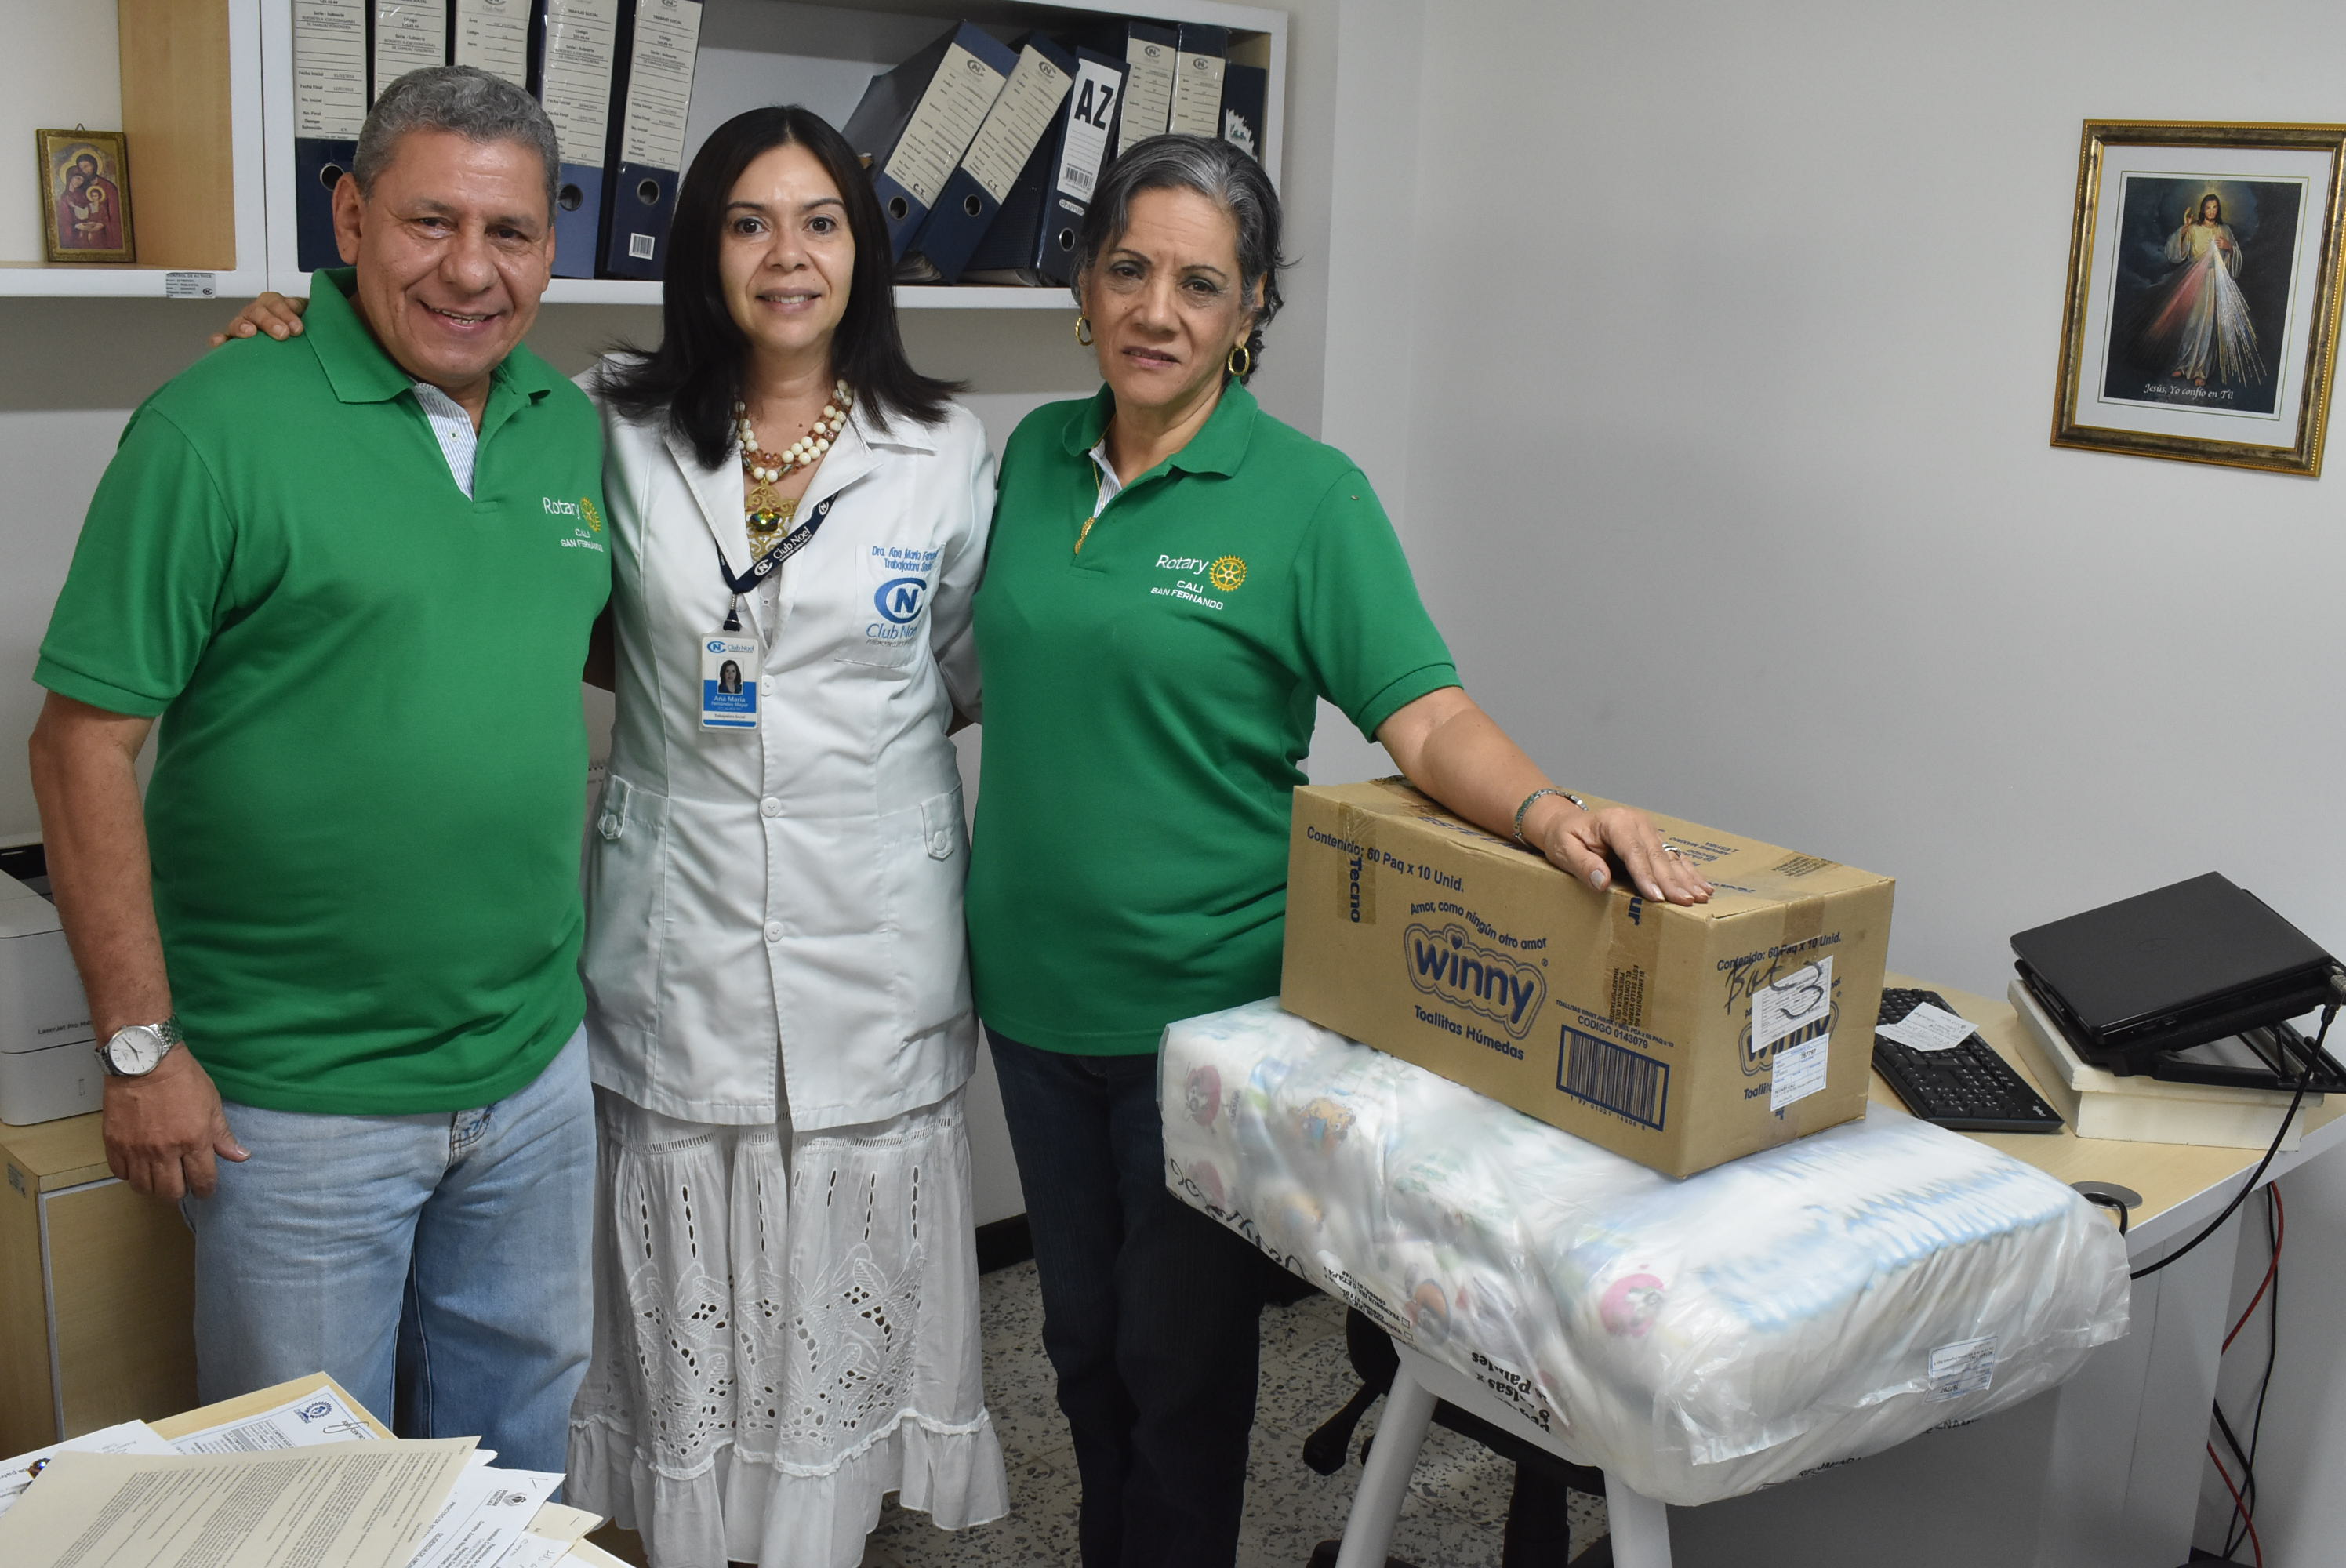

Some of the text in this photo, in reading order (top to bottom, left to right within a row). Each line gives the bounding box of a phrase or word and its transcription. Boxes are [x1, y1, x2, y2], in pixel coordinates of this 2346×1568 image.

[1073, 78, 1114, 131] AZ
[2170, 385, 2181, 394] Yo
[543, 496, 580, 520] Rotary
[560, 539, 577, 548] SAN
[773, 541, 794, 560] Club
[791, 526, 811, 546] Noel
[888, 546, 902, 559] Ana
[884, 557, 919, 572] Trabajadora
[1155, 554, 1209, 575] Rotary
[1176, 580, 1204, 593] CALI
[1150, 587, 1223, 610] SAN FERNANDO
[866, 623, 899, 640] Club
[1306, 826, 1465, 893] Contenido: 60 Paq x 10 Unid.
[1349, 857, 1363, 923] Tecno
[1411, 902, 1547, 950] Amor, como ningún otro amor
[1717, 951, 1767, 971] Contenido:
[1768, 946, 1778, 958] 60
[1820, 931, 1842, 947] Unid.
[1556, 999, 1581, 1014] TOALLITAS
[1414, 1005, 1525, 1061] Toallitas Húmedas
[1578, 1015, 1649, 1049] CODIGO 0143079
[1744, 1081, 1773, 1100] Toallit
